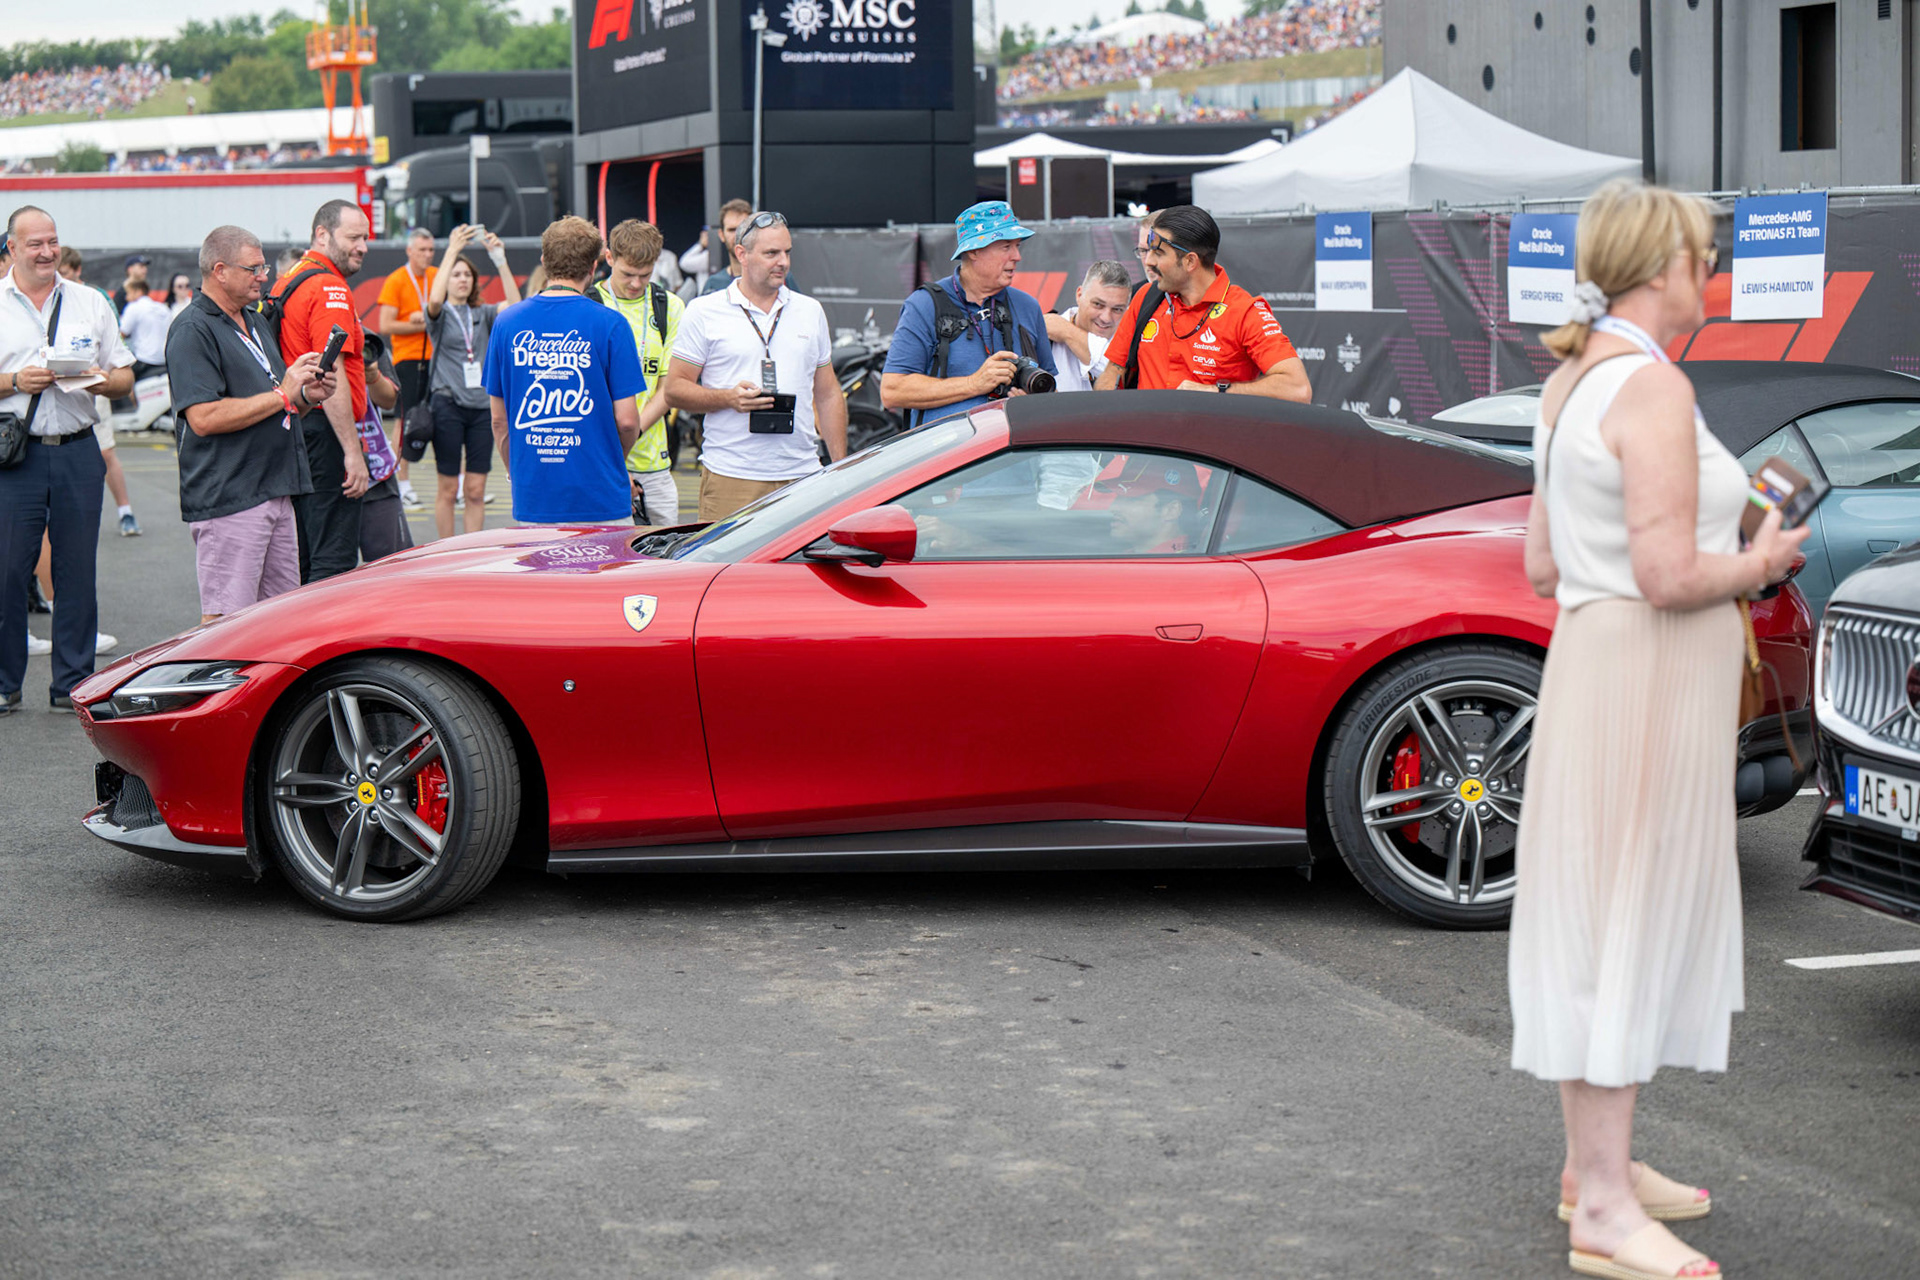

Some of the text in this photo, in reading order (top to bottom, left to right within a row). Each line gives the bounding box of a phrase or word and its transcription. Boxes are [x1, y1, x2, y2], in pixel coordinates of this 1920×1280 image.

[829, 0, 916, 29] MSC
[829, 31, 917, 43] CRUISES
[781, 51, 813, 62] Global
[814, 51, 850, 62] Partner
[850, 51, 863, 62] of
[863, 51, 904, 62] Formula
[1748, 210, 1812, 226] Mercedes-AMG
[1531, 228, 1552, 239] Oracle
[1739, 226, 1820, 242] PETRONAS F1 Team
[1518, 241, 1565, 256] Red Bull Racing
[1741, 281, 1813, 294] LEWIS HAMILTON
[1520, 290, 1563, 302] SERGIO PEREZ
[512, 329, 592, 353] Porcelain
[1193, 342, 1221, 352] Santander
[514, 347, 591, 368] Dreams
[1358, 669, 1431, 735] BRIDGESTONE
[1848, 792, 1857, 808] H
[1862, 774, 1887, 818] AE
